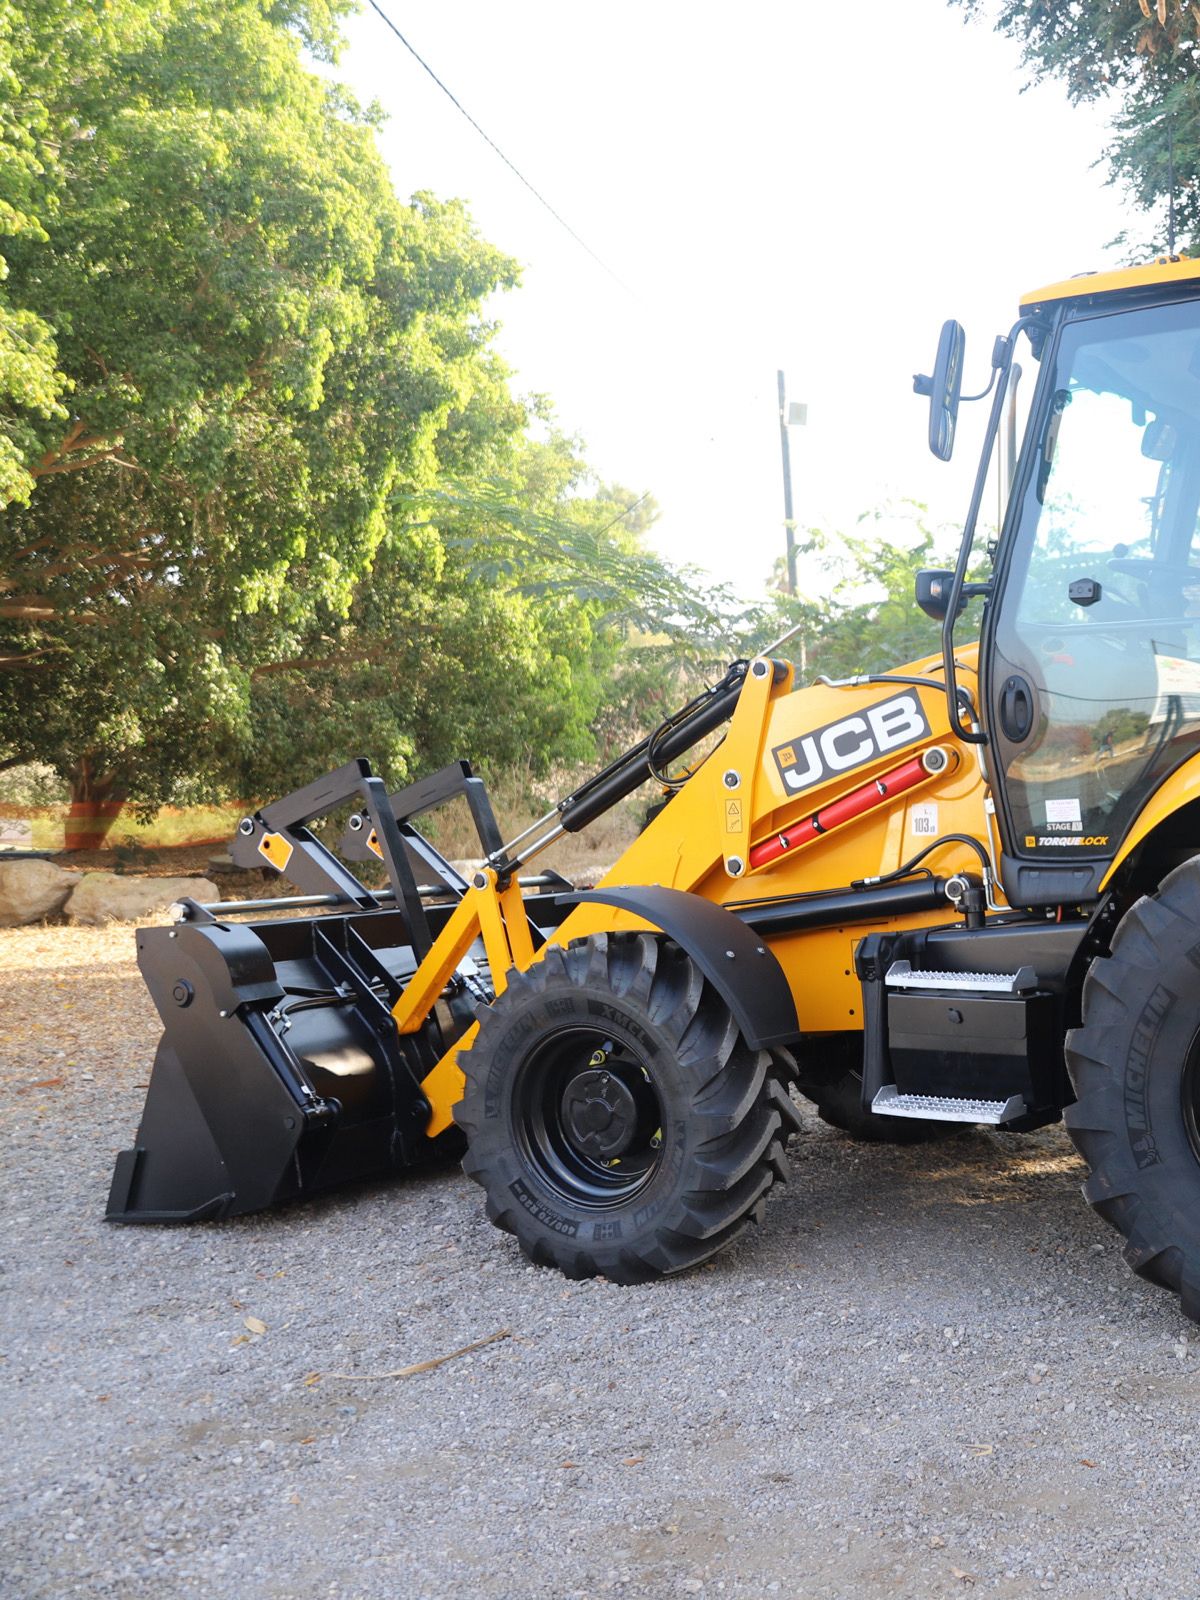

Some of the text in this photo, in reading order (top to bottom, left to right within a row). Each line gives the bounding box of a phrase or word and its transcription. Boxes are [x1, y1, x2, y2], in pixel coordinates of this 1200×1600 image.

[784, 696, 925, 789] JCB
[914, 817, 930, 832] 103
[1046, 823, 1071, 831] STAGE
[1039, 836, 1109, 847] TORQUELOCK
[602, 1004, 649, 1044] XMCL
[1126, 983, 1172, 1130] MICHELIN
